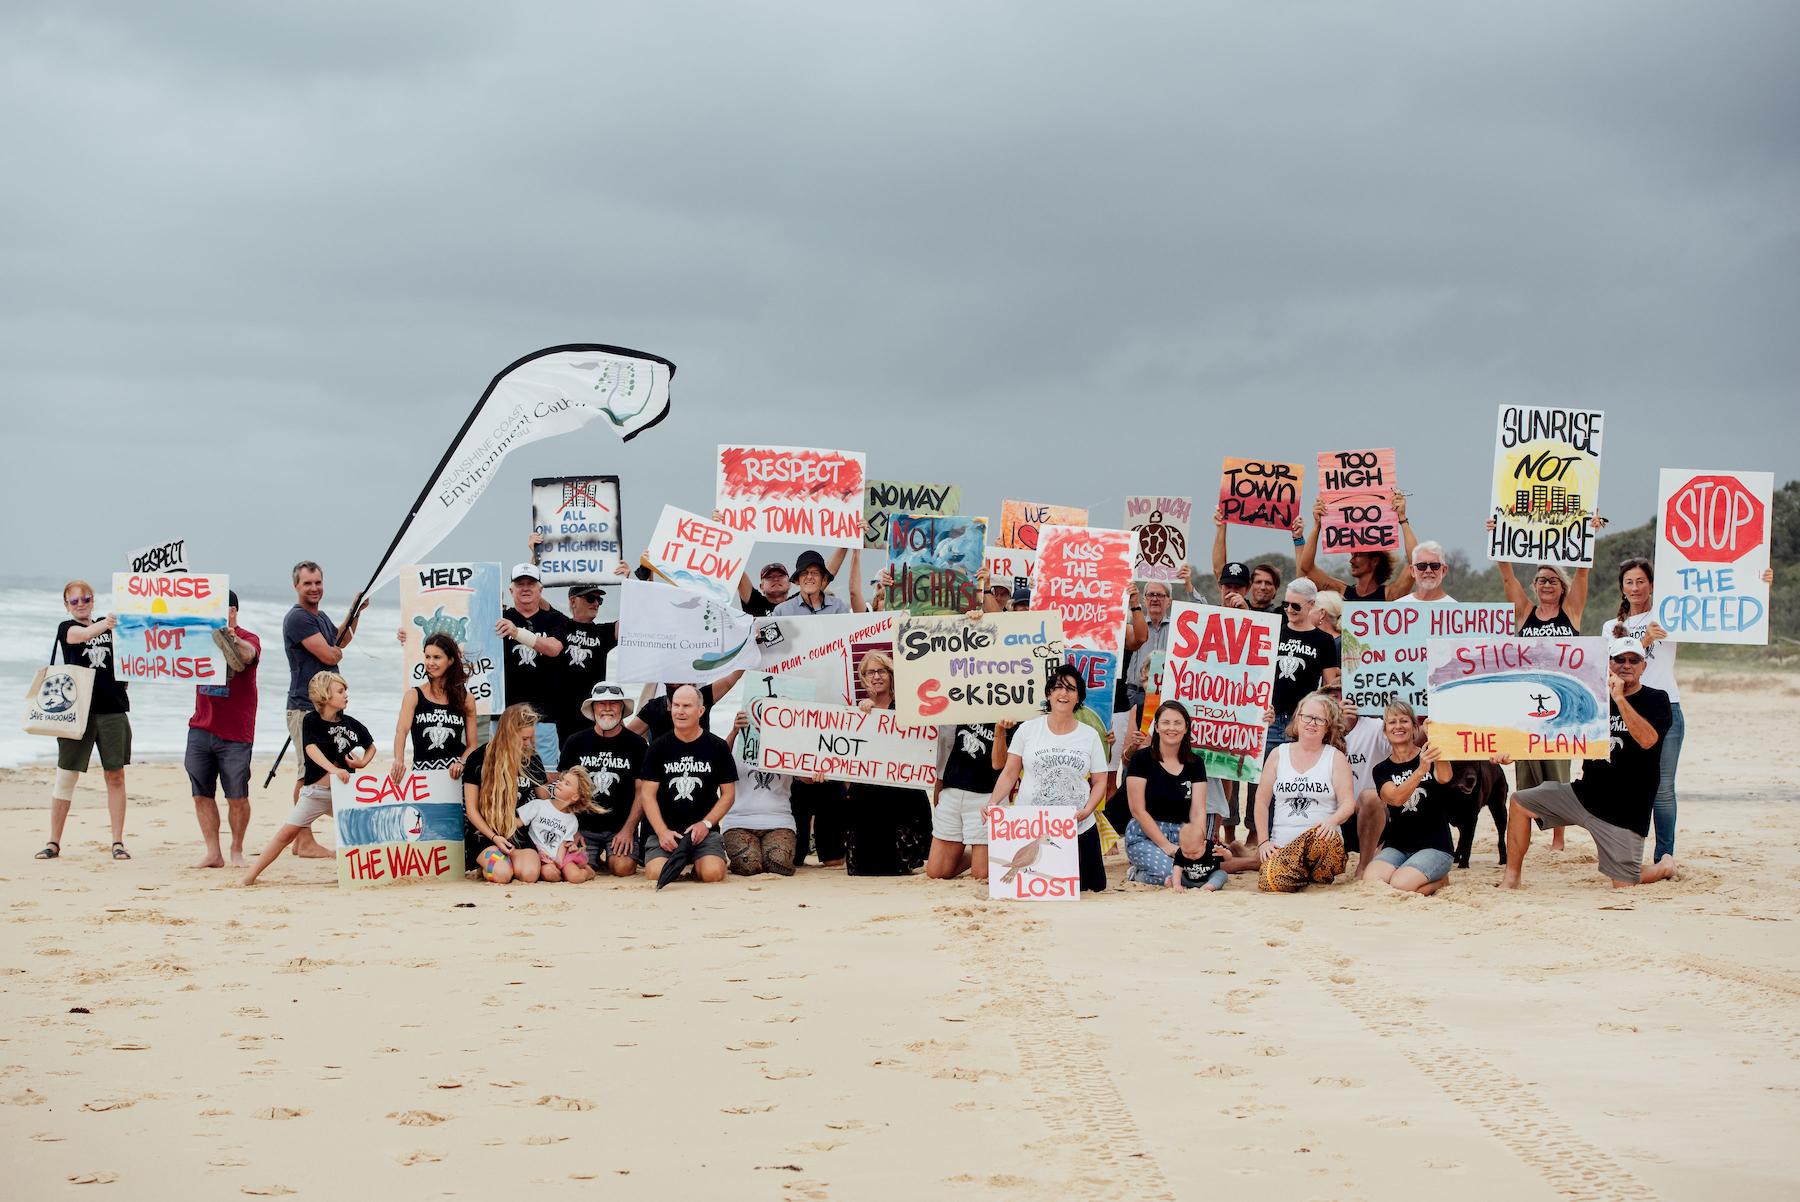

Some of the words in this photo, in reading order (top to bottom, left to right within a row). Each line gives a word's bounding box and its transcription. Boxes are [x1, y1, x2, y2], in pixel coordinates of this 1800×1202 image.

[1502, 407, 1602, 457] SUNRISE
[442, 438, 494, 490] SUNSHINE
[493, 403, 525, 440] COAST
[439, 414, 534, 508] Environment
[742, 457, 845, 484] RESPECT
[1244, 462, 1297, 481] OUR
[1335, 452, 1377, 469] TOO
[1513, 450, 1582, 482] NOT
[1325, 467, 1383, 490] HIGH
[563, 510, 587, 521] ALL
[722, 506, 757, 532] OUR
[762, 505, 814, 536] TOWN
[818, 508, 861, 539] PLAN
[1025, 506, 1051, 523] WE
[1127, 497, 1150, 517] NO
[1156, 497, 1192, 524] HIGH
[1222, 498, 1292, 527] PLAN
[1338, 505, 1382, 523] TOO
[1671, 482, 1754, 551] STOP
[536, 524, 552, 534] ON
[560, 522, 608, 534] BOARD
[676, 517, 733, 552] KEEP
[1325, 525, 1396, 548] DENSE
[1490, 514, 1594, 562] HIGHRISE
[558, 540, 618, 553] HIGHRISE
[1062, 542, 1104, 561] KISS
[541, 559, 604, 573] SEKISUI
[661, 541, 683, 562] IT
[686, 548, 742, 581] LOW
[1063, 561, 1098, 578] THE
[1137, 565, 1178, 581] RISE
[128, 575, 211, 599] SUNRISE
[419, 567, 473, 588] HELP
[1050, 576, 1113, 599] PEACE
[1676, 568, 1735, 593] THE
[1350, 607, 1419, 637] STOP
[1430, 608, 1515, 636] HIGHRISE
[1658, 595, 1764, 633] GREED
[144, 624, 185, 652] NOT
[620, 636, 677, 650] Environment
[679, 637, 719, 650] Council
[905, 626, 991, 661] Smoke
[1003, 620, 1046, 646] and
[1172, 609, 1272, 666] SAVE
[1522, 626, 1573, 637] YAROOMBA
[121, 654, 216, 679] HIGHRISE
[781, 655, 802, 671] PLAN
[809, 638, 845, 660] COUNCIL
[1361, 649, 1386, 664] ON
[1456, 642, 1534, 675] STICK
[1555, 643, 1585, 669] TO
[950, 656, 1034, 679] Mirrors
[1170, 660, 1271, 711] Yaroomba
[1353, 671, 1416, 690] SPEAK
[29, 709, 44, 721] SAVE
[45, 712, 77, 723] YAROOMBA
[415, 713, 464, 726] YAROOMBA
[763, 705, 867, 732] COMMUNITY
[1193, 704, 1237, 722] FROM
[818, 734, 868, 757] NOT
[1190, 721, 1259, 750] STRUCTION
[1456, 731, 1497, 754] THE
[1528, 733, 1587, 754] PLAN
[579, 756, 630, 769] YAROOMBA
[663, 762, 711, 773] YAROOMBA
[764, 748, 883, 778] DEVELOPMENT
[886, 761, 937, 784] RIGHTS
[356, 774, 430, 803] SAVE
[1276, 782, 1330, 794] YAROOMBA
[989, 807, 1076, 841] Paradise
[345, 848, 385, 880] THE
[386, 843, 450, 879] WAVE
[1017, 872, 1080, 898] LOST
